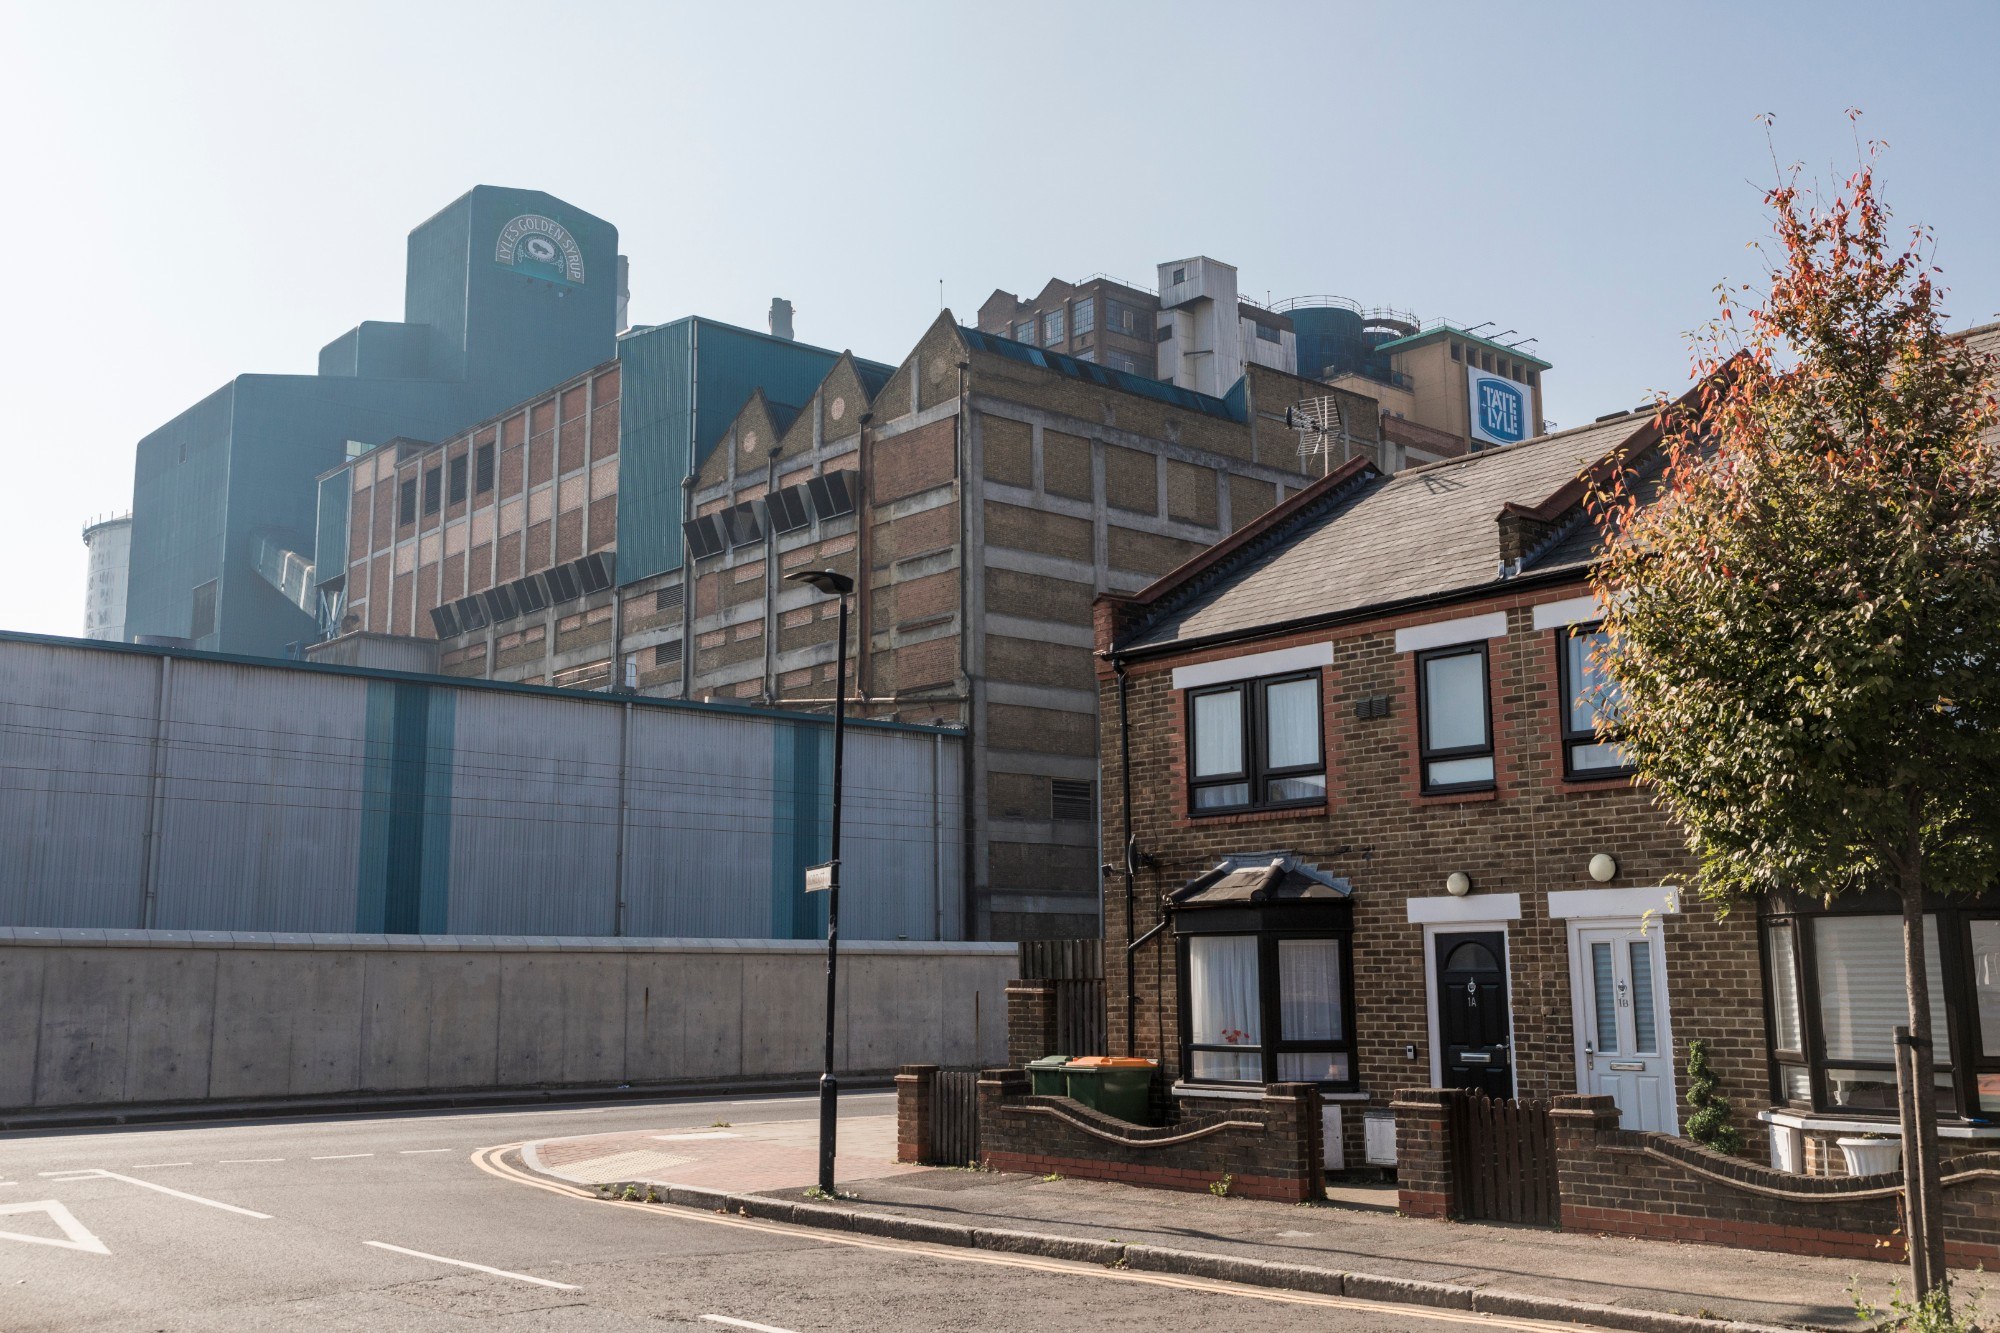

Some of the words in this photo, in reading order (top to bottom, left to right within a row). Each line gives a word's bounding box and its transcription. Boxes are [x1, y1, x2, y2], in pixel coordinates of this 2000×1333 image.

[499, 226, 519, 260] LYLE'S
[518, 218, 565, 241] GOLDEN
[562, 239, 581, 279] SYRUP
[1483, 386, 1516, 415] TATE
[1487, 407, 1518, 435] LYLE
[1467, 997, 1477, 1007] 1A
[1617, 998, 1629, 1008] 1B
